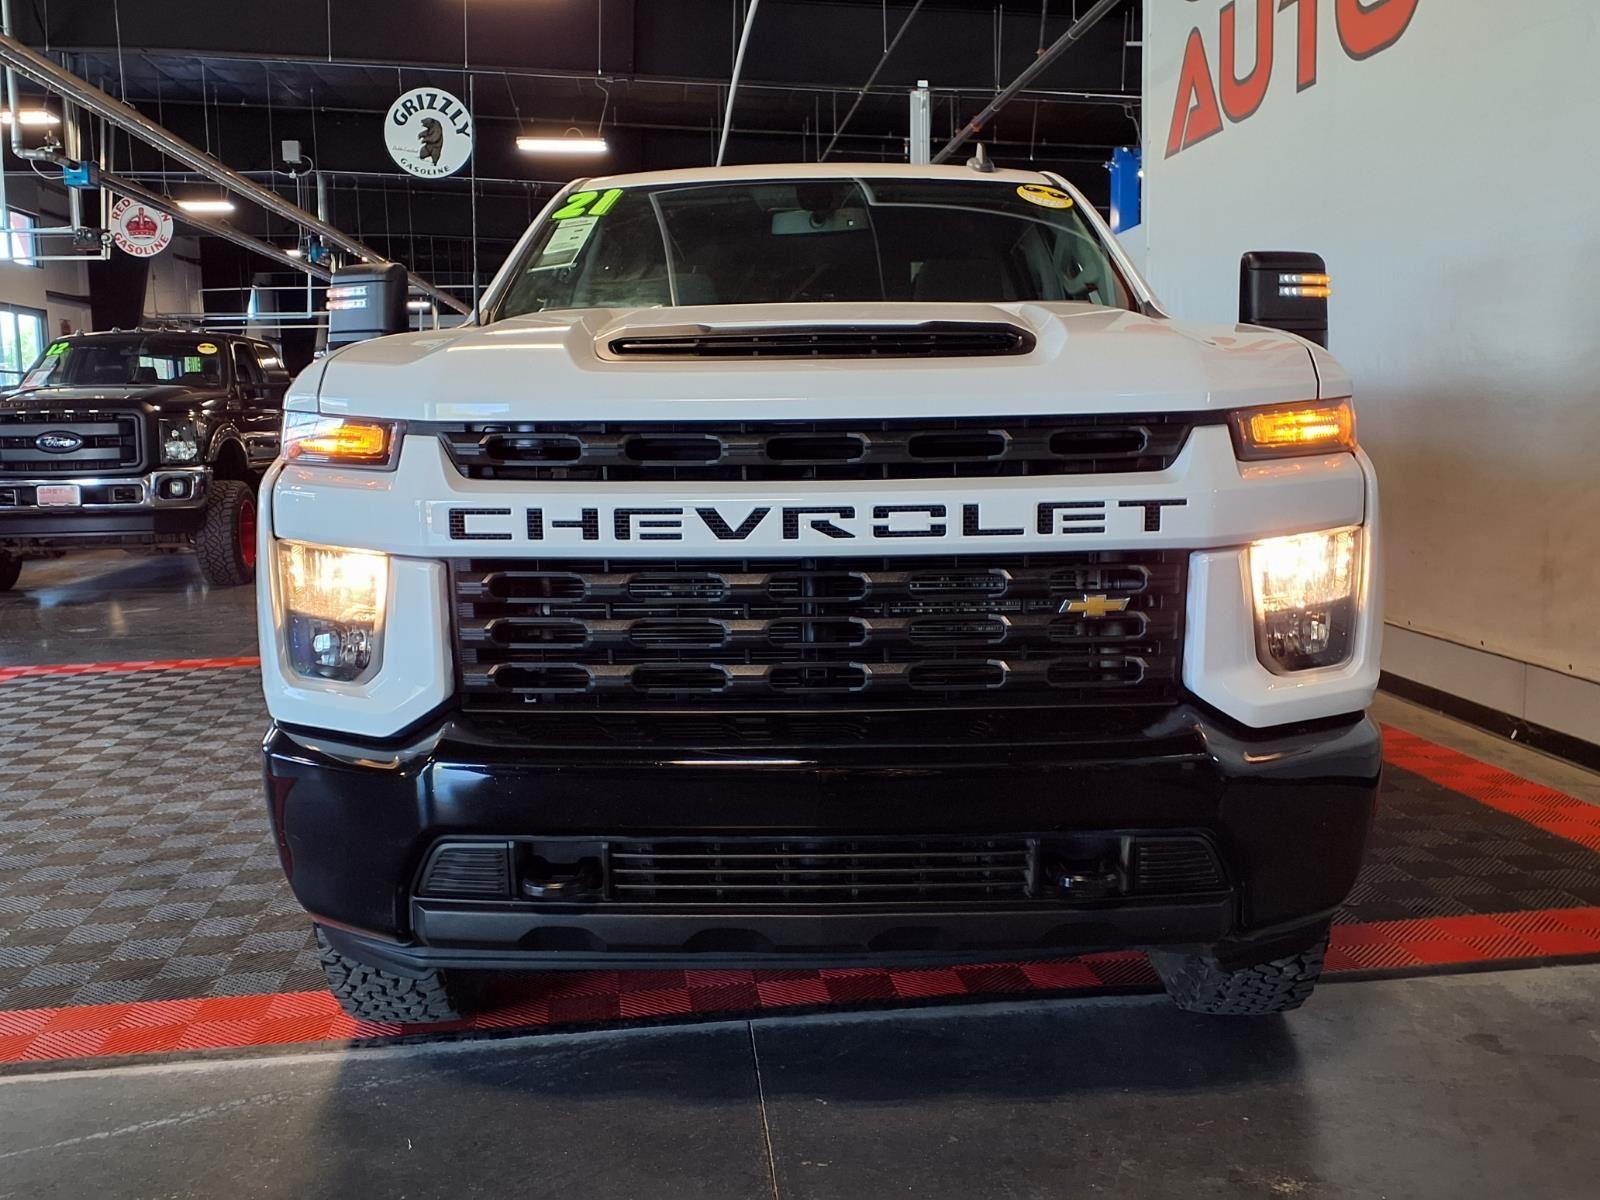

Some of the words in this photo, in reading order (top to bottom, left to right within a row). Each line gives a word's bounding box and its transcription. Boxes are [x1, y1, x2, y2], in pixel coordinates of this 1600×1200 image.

[393, 93, 471, 137] GRIZZLY
[400, 157, 450, 175] GASOLINE
[112, 198, 131, 220] RED
[551, 188, 624, 219] 21
[114, 232, 169, 255] GASOLINE
[45, 342, 70, 356] 12
[449, 498, 1187, 540] CHEVROLET
